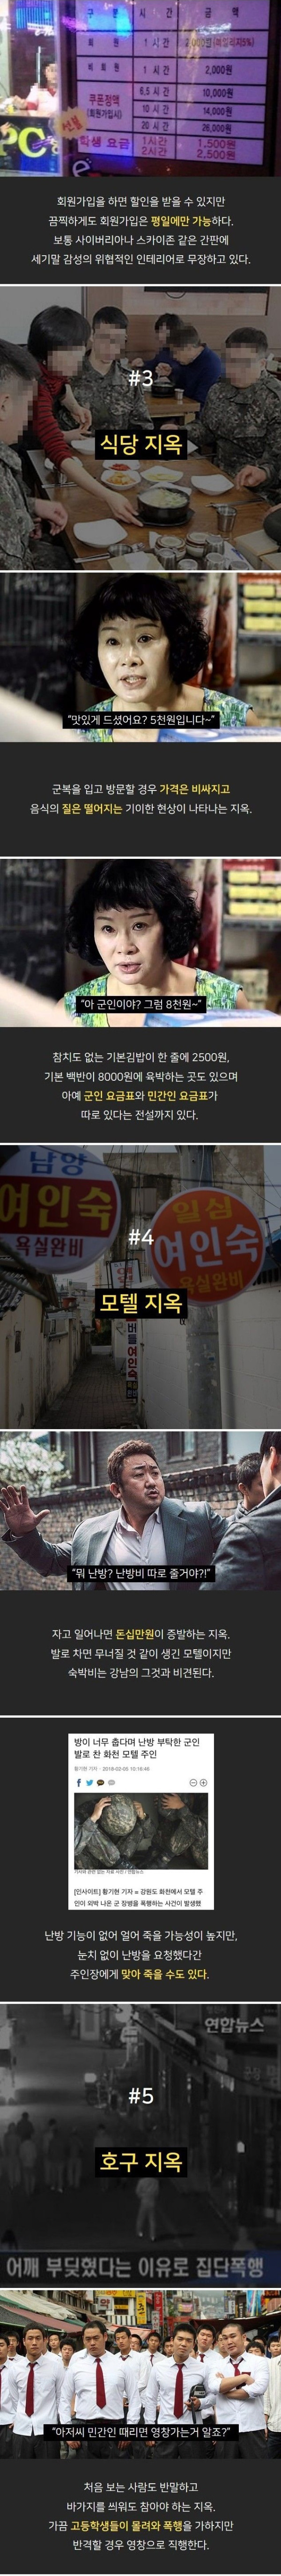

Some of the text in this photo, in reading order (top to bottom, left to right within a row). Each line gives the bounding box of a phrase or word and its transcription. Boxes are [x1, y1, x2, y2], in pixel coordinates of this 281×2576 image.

[206, 65, 232, 75] 2,000원
[203, 88, 233, 99] 10,000원
[89, 94, 120, 107] 쿠폰정액
[203, 106, 232, 117] 14,000원
[202, 124, 231, 134] 26,000원
[0, 127, 46, 158] PC
[79, 136, 130, 149] 학생 요금
[30, 1151, 88, 1176] 남양
[0, 1183, 112, 1231] 여인숙
[172, 1196, 232, 1224] 일심
[15, 1236, 83, 1258] 욕실완비
[154, 1224, 259, 1271] 여인숙
[179, 1270, 244, 1294] 욕실완비
[74, 1737, 200, 1747] 방이 너무 춥다며 난방 부탁한 군인
[74, 1749, 157, 1759] 발로 찬 화천 모텔 주인
[100, 2299, 110, 2309] 약
